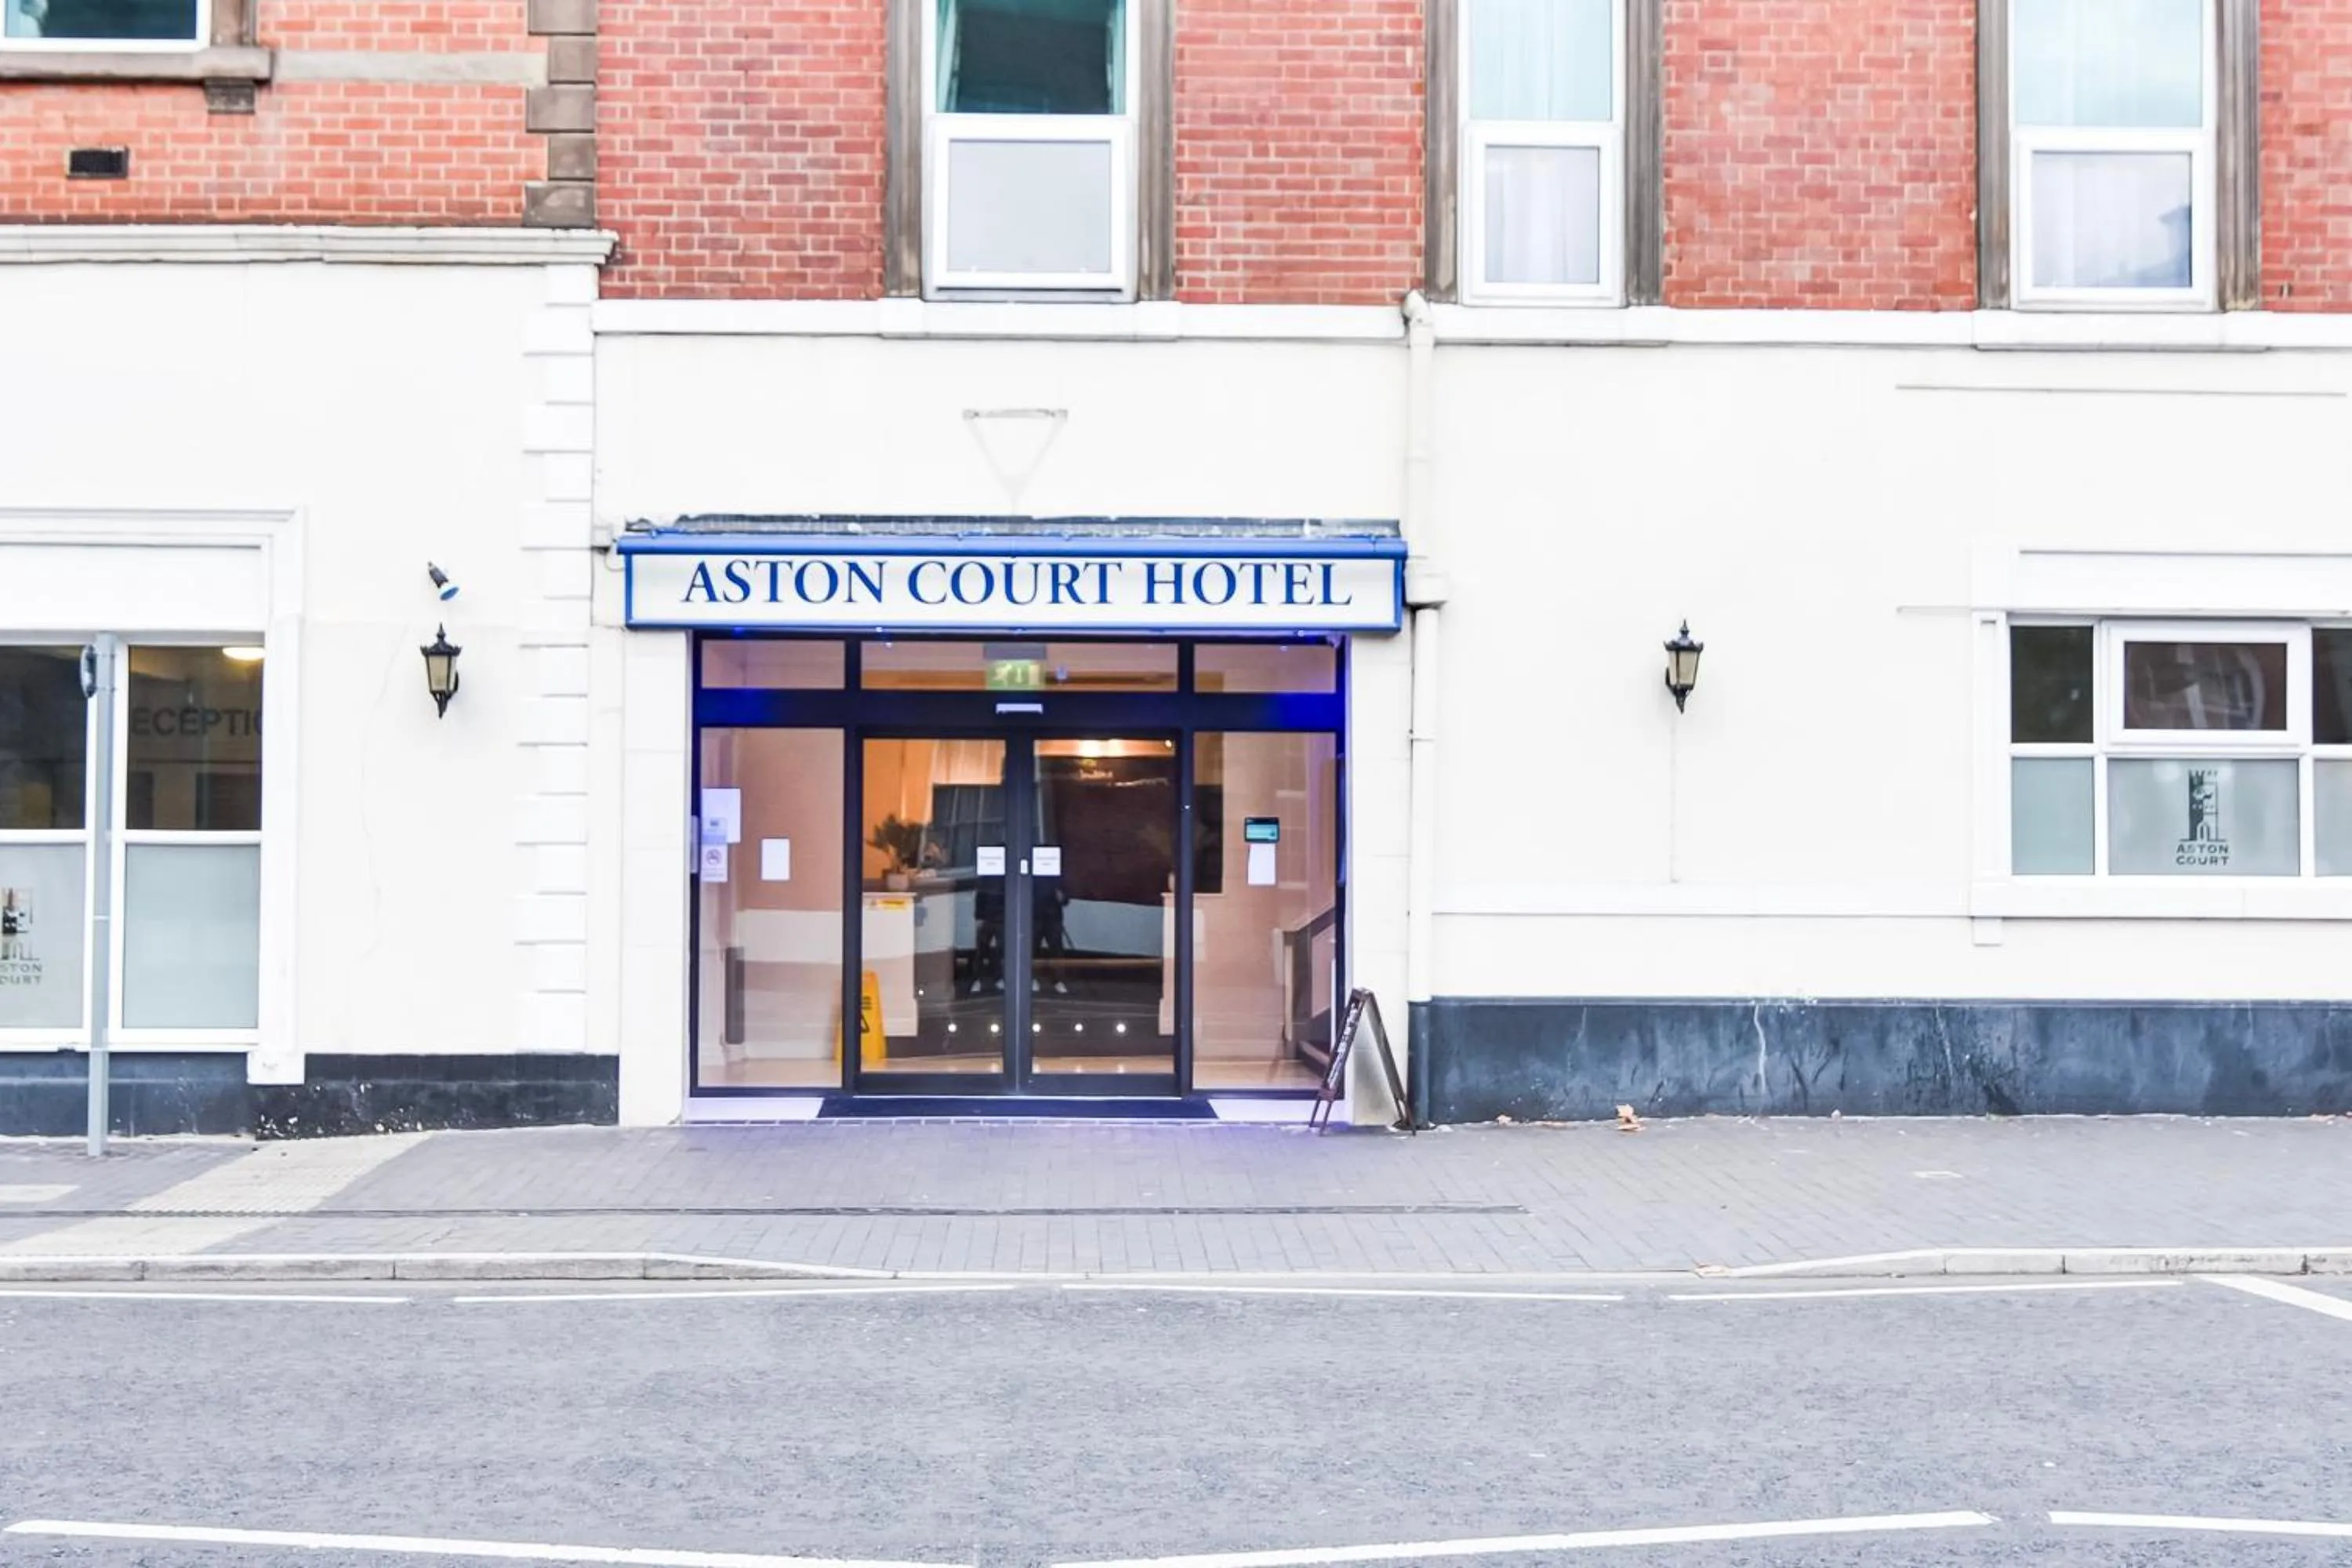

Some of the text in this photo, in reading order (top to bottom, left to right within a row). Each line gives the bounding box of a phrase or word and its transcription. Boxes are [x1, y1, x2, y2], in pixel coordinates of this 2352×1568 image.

[681, 559, 1352, 606] ASTON COURT HOTEL
[2176, 844, 2229, 854] ASTON
[2176, 855, 2230, 866] COURT
